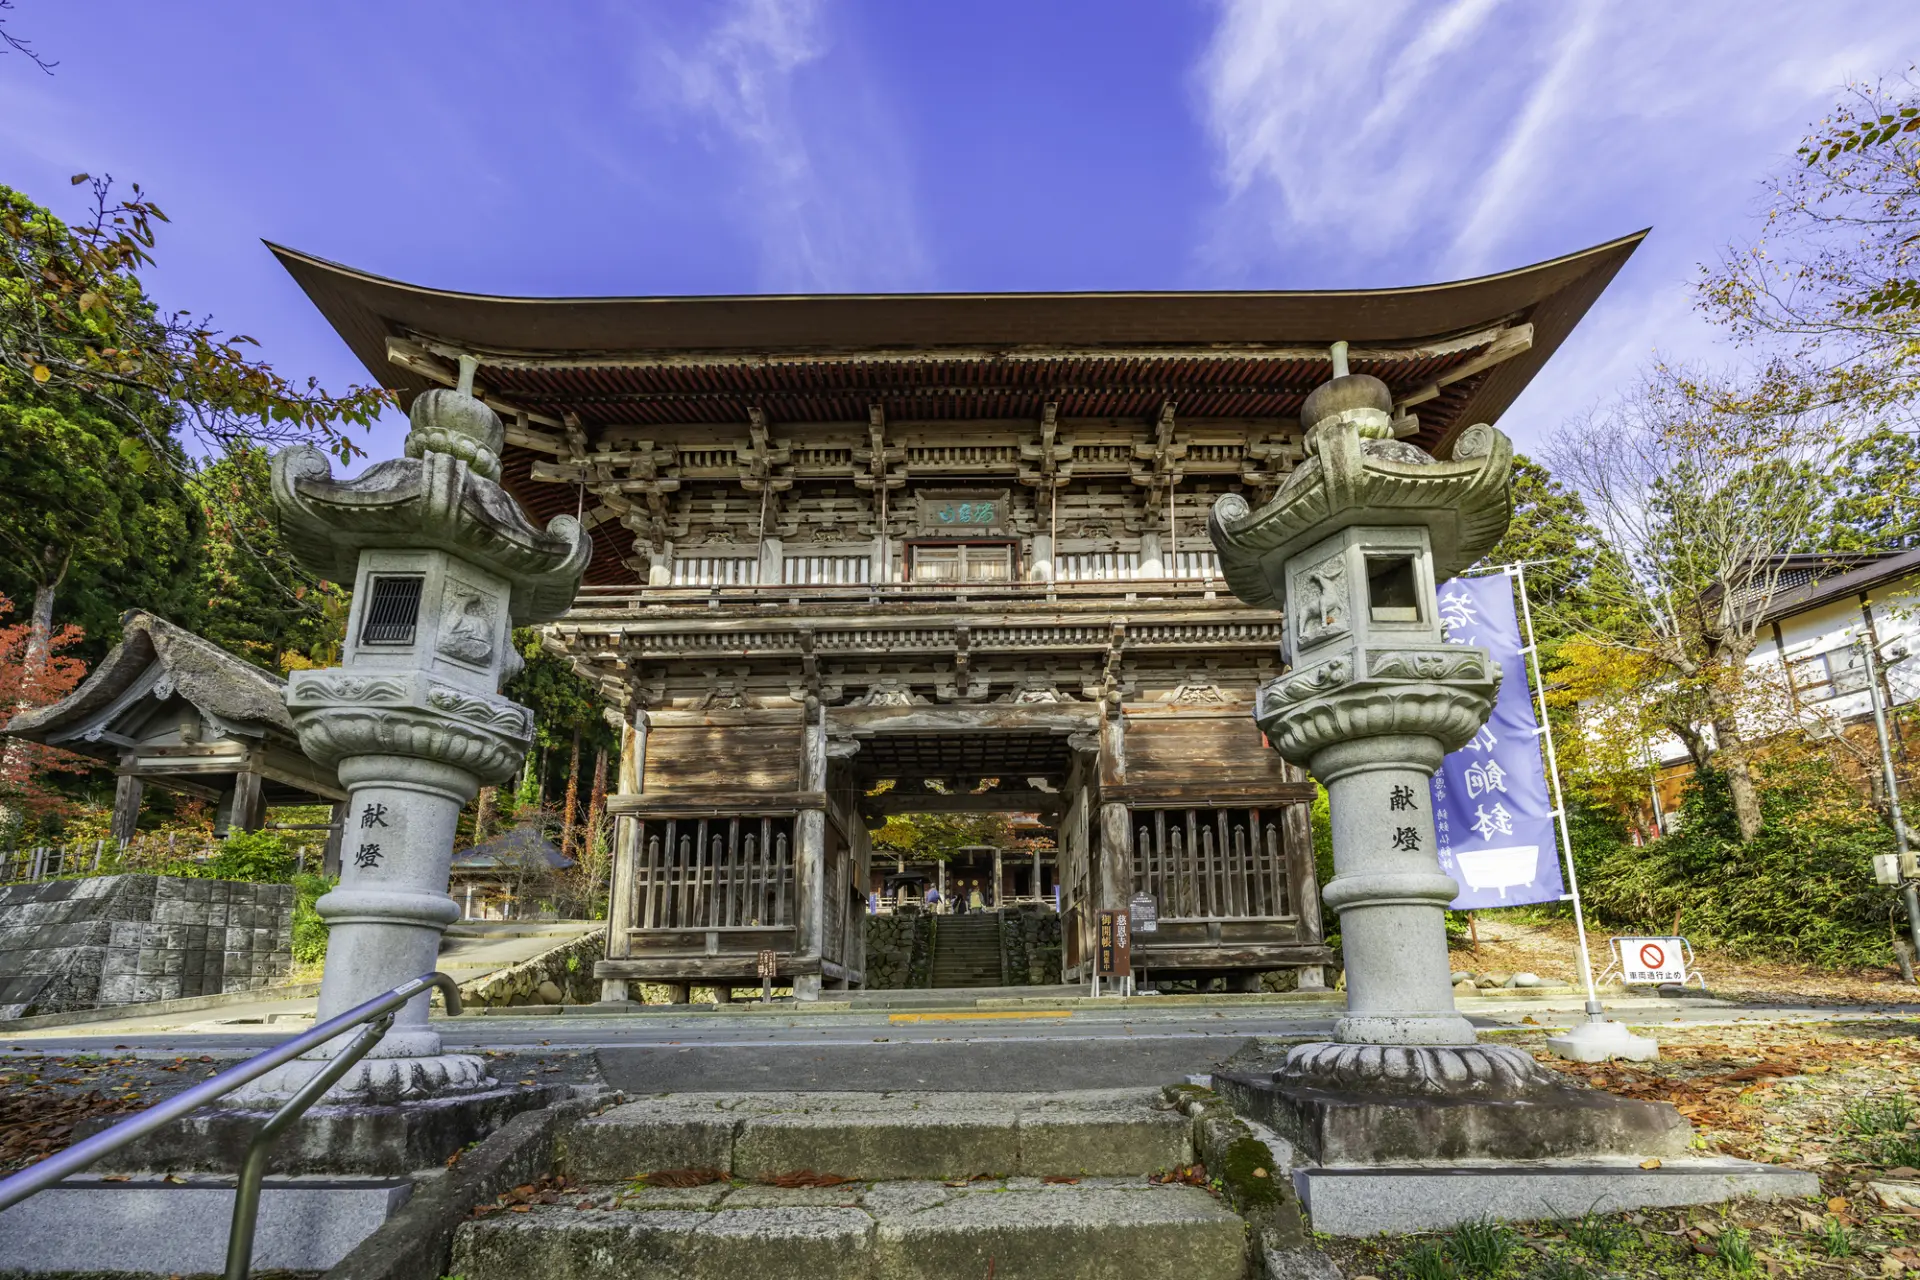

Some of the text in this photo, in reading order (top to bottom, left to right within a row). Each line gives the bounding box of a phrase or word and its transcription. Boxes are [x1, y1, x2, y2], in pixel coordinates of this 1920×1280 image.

[353, 803, 389, 869] 献燈
[1389, 784, 1422, 852] 献燈
[1629, 971, 1682, 980] 車両通行止め
